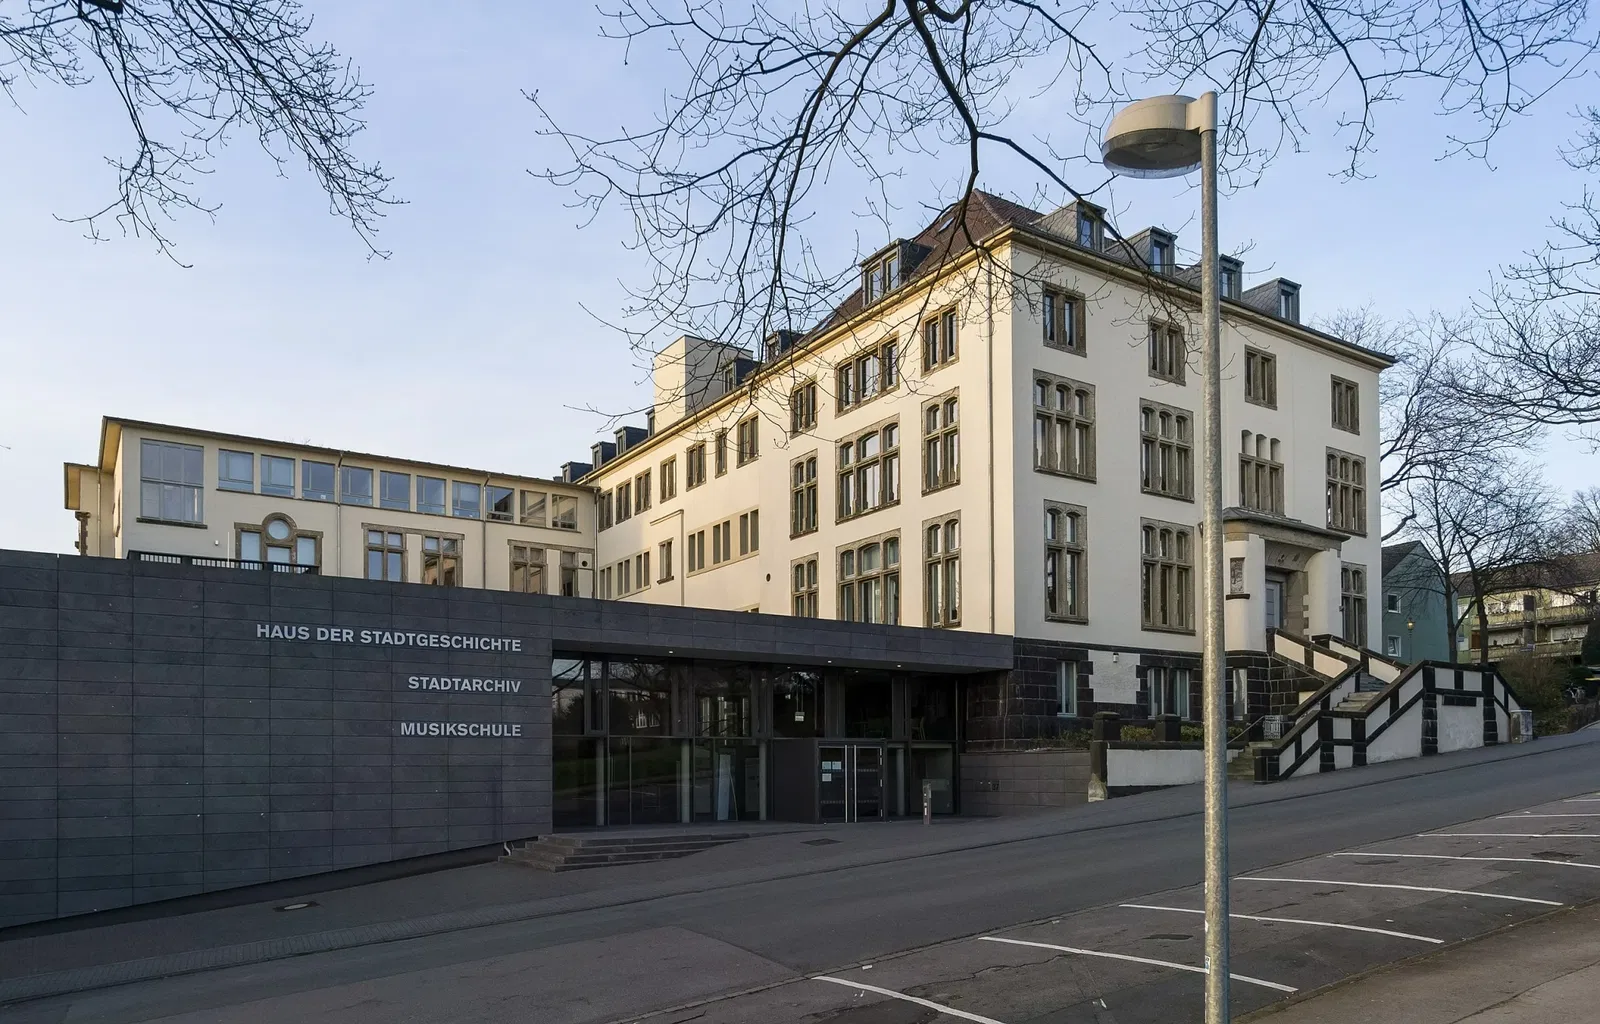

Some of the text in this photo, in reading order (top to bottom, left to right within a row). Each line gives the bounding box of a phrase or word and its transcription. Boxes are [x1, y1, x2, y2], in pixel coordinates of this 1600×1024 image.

[256, 624, 522, 651] HAUS DER STADTGESCHICHTE
[408, 676, 521, 693] STADTARCHIV
[400, 722, 522, 737] MUSIKSCHULE
